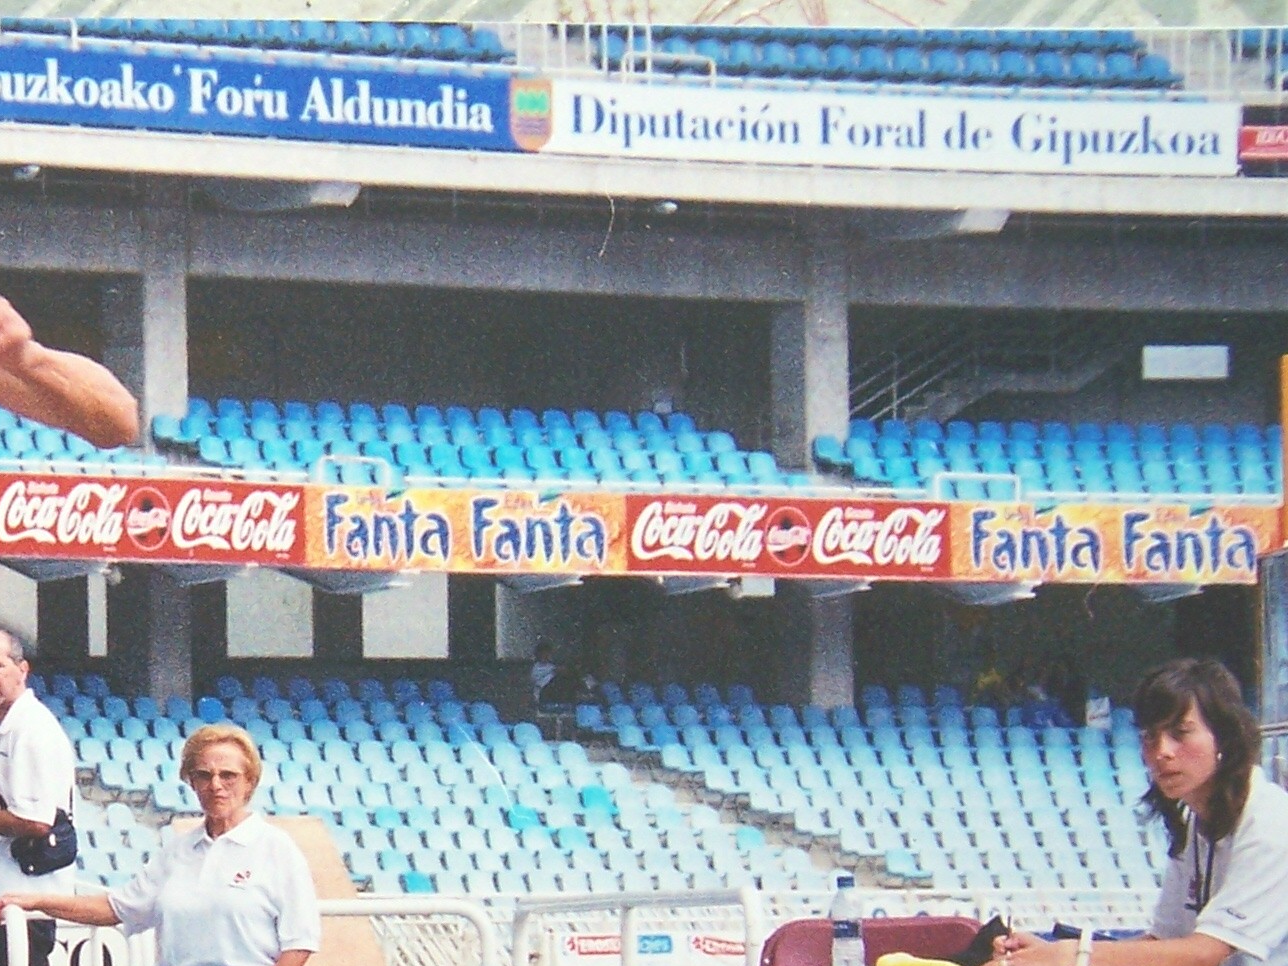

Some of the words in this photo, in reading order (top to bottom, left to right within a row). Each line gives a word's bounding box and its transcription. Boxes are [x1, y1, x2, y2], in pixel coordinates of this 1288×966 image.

[189, 68, 288, 120] Foru
[299, 84, 493, 134] Aldundia
[571, 93, 800, 148] Diputación
[820, 106, 927, 151] Foral
[944, 111, 993, 152] de
[1011, 111, 1220, 165] Gipuzkoa
[325, 493, 450, 562] Fanta
[472, 497, 606, 563] Fanta
[971, 510, 1101, 573] Fanta
[1124, 511, 1257, 574] Fanta
